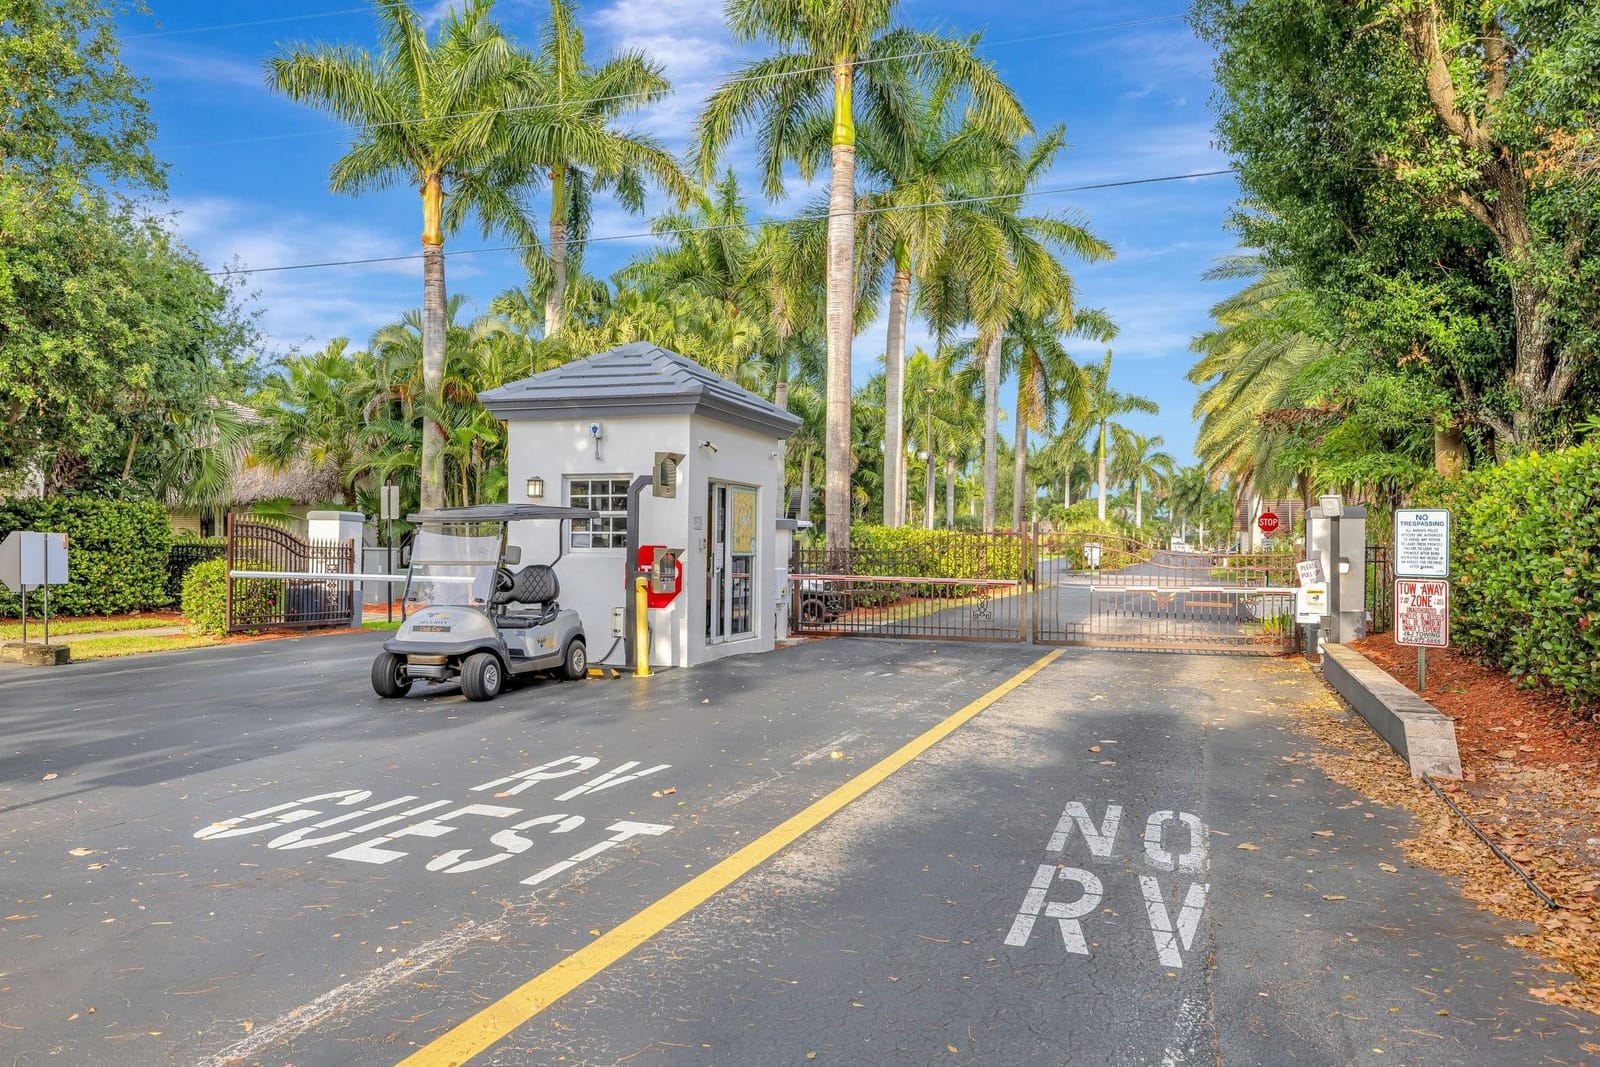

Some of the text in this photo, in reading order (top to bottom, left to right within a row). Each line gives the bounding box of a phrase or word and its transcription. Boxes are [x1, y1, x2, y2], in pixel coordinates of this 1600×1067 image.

[1399, 583, 1444, 596] TOW AWAY
[1411, 596, 1432, 607] ZONE
[469, 755, 672, 801] RV
[193, 790, 675, 885] GUEST
[1046, 801, 1210, 874] NO
[1004, 864, 1210, 968] RV
